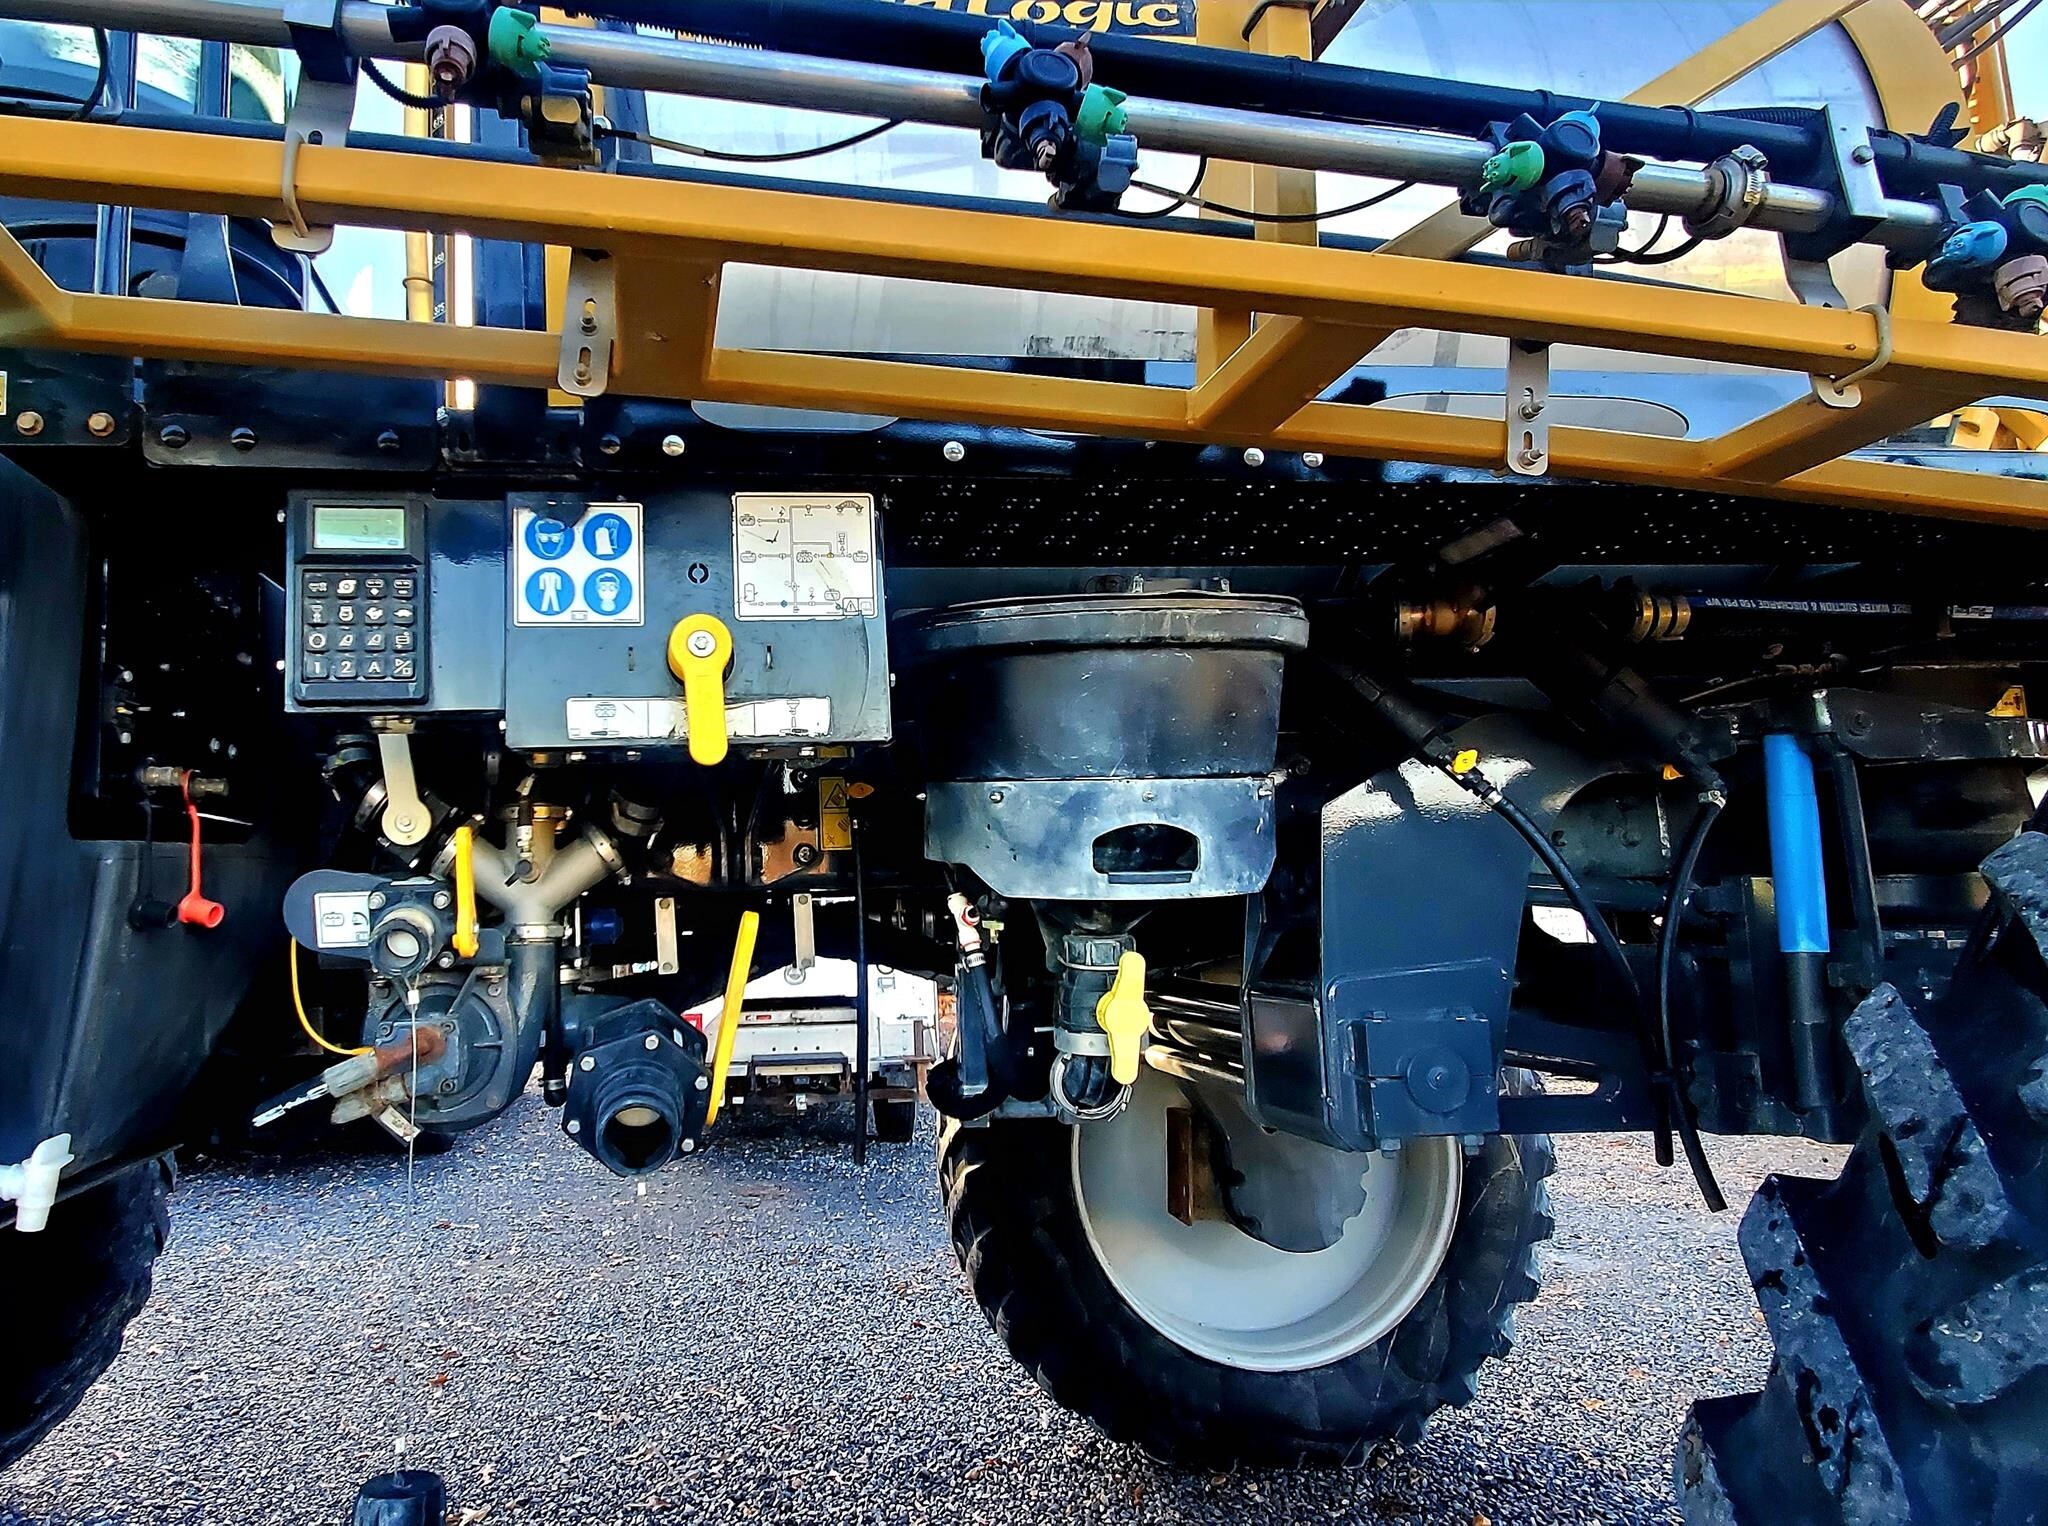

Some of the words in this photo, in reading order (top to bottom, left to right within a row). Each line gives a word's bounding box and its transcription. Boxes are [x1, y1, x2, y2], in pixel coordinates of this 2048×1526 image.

[1721, 598, 1739, 608] PSI
[1758, 600, 1809, 611] DISCHARGE
[1810, 601, 1818, 611] &
[1819, 601, 1858, 613] SUCTION
[1860, 603, 1890, 613] WATER
[313, 661, 321, 674] 1
[340, 660, 352, 673] 2
[368, 661, 381, 673] A
